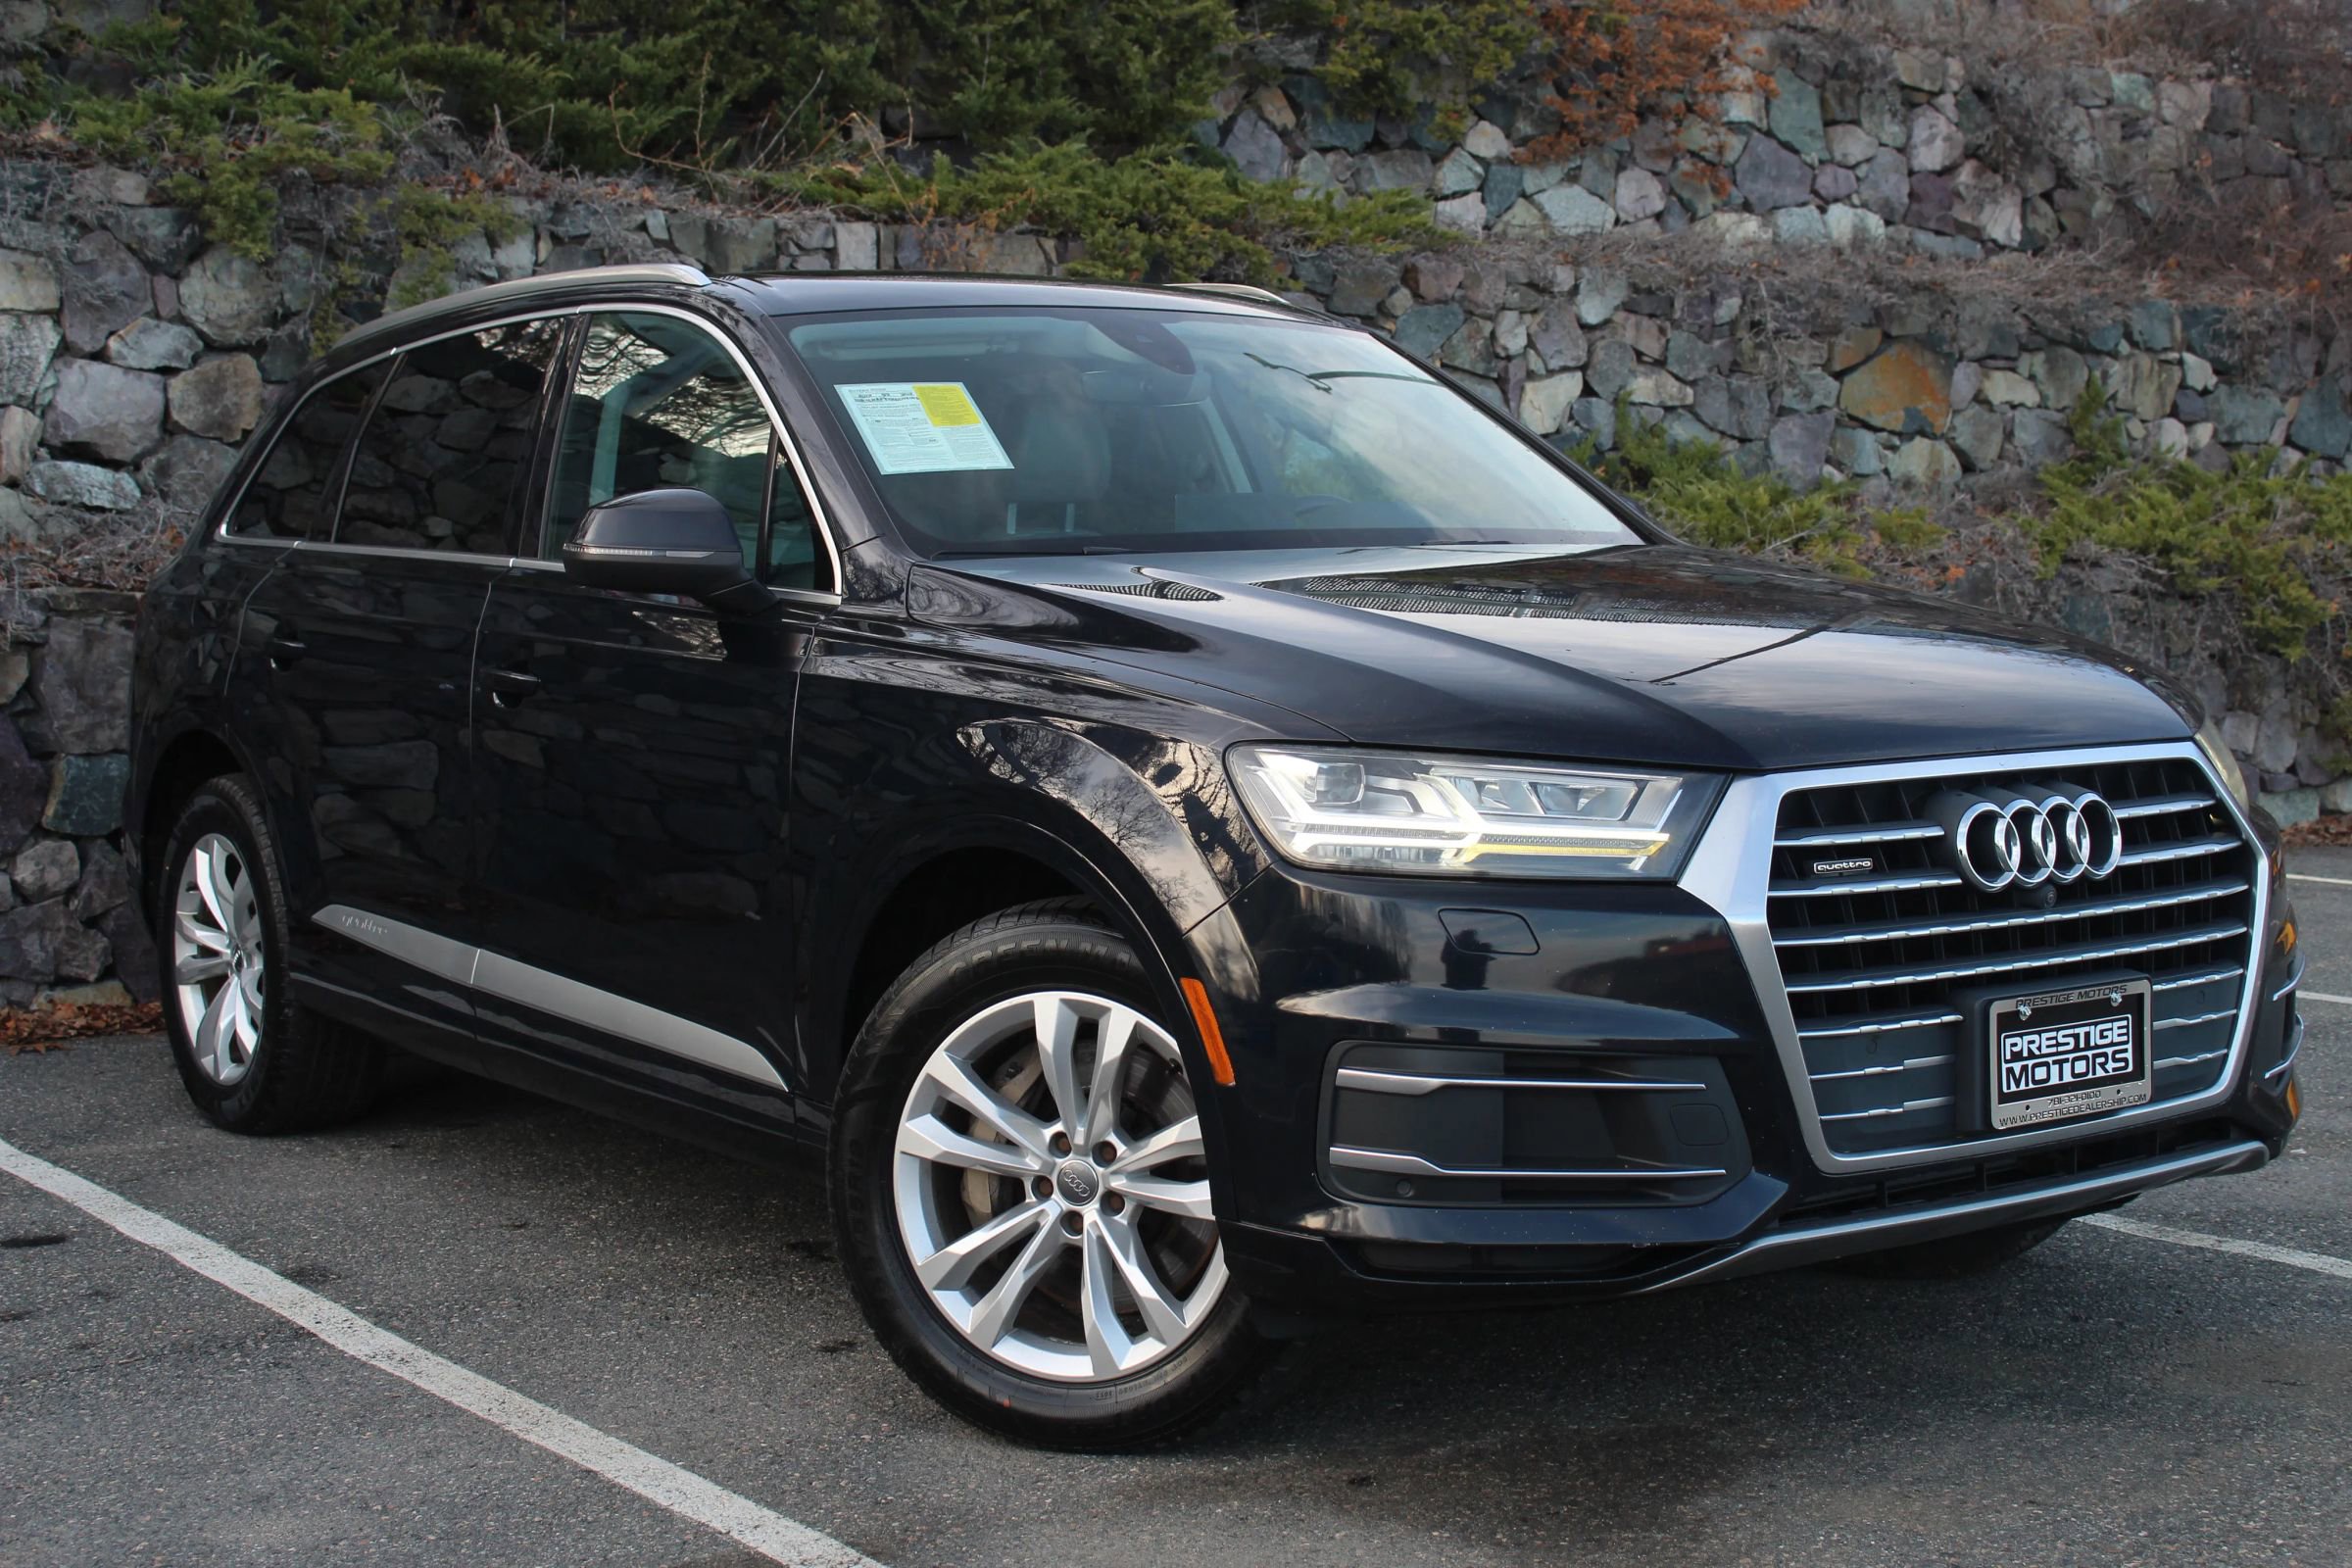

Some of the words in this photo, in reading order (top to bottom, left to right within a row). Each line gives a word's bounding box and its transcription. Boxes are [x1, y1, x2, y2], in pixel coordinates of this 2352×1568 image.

[1817, 861, 1871, 871] quattro
[2016, 993, 2075, 1009] PRESTIGE
[2077, 985, 2128, 1001] MOTORS
[2005, 1020, 2129, 1060] PRESTIGE
[2005, 1048, 2130, 1091] MOTORS
[1999, 1094, 2147, 1127] WWW.PRESTIGEDEALERSHIP.COM
